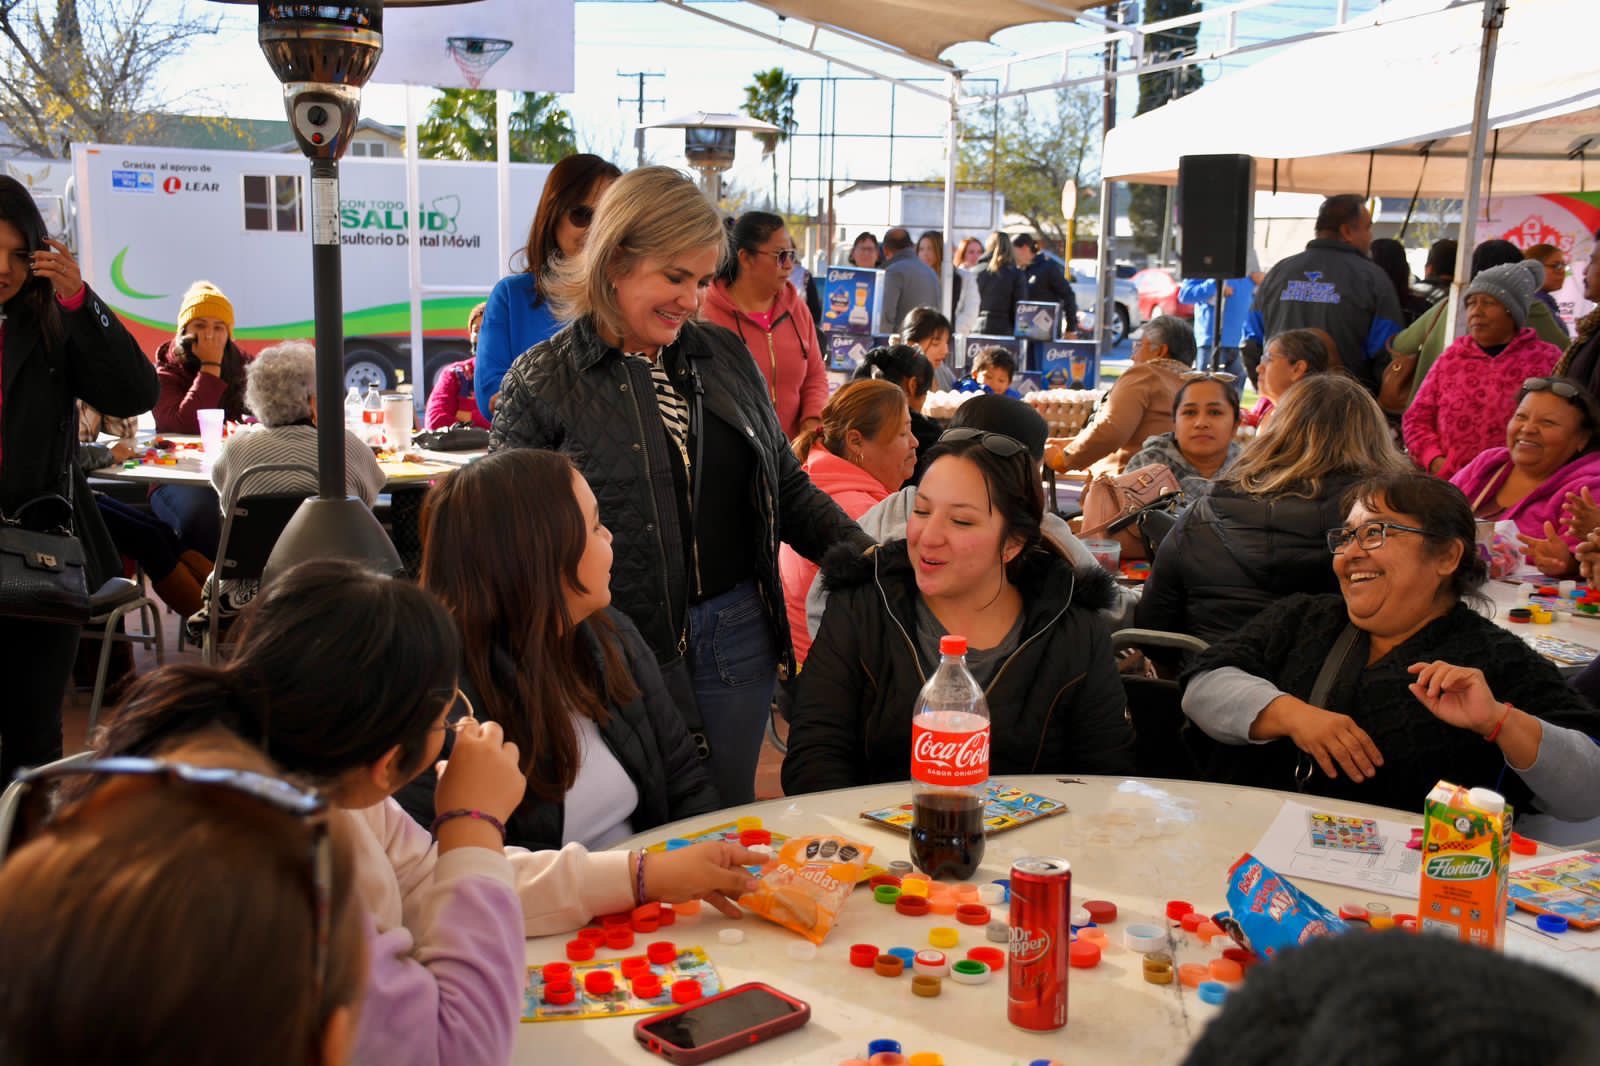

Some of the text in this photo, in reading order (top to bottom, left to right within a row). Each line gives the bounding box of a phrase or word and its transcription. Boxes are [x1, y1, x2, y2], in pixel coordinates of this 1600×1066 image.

[122, 160, 156, 169] Gracias
[170, 164, 198, 172] apoyo
[200, 164, 212, 172] de
[185, 181, 220, 192] LEAR
[369, 200, 404, 210] TODO
[442, 235, 481, 248] Móvil
[927, 768, 952, 777] SABOR
